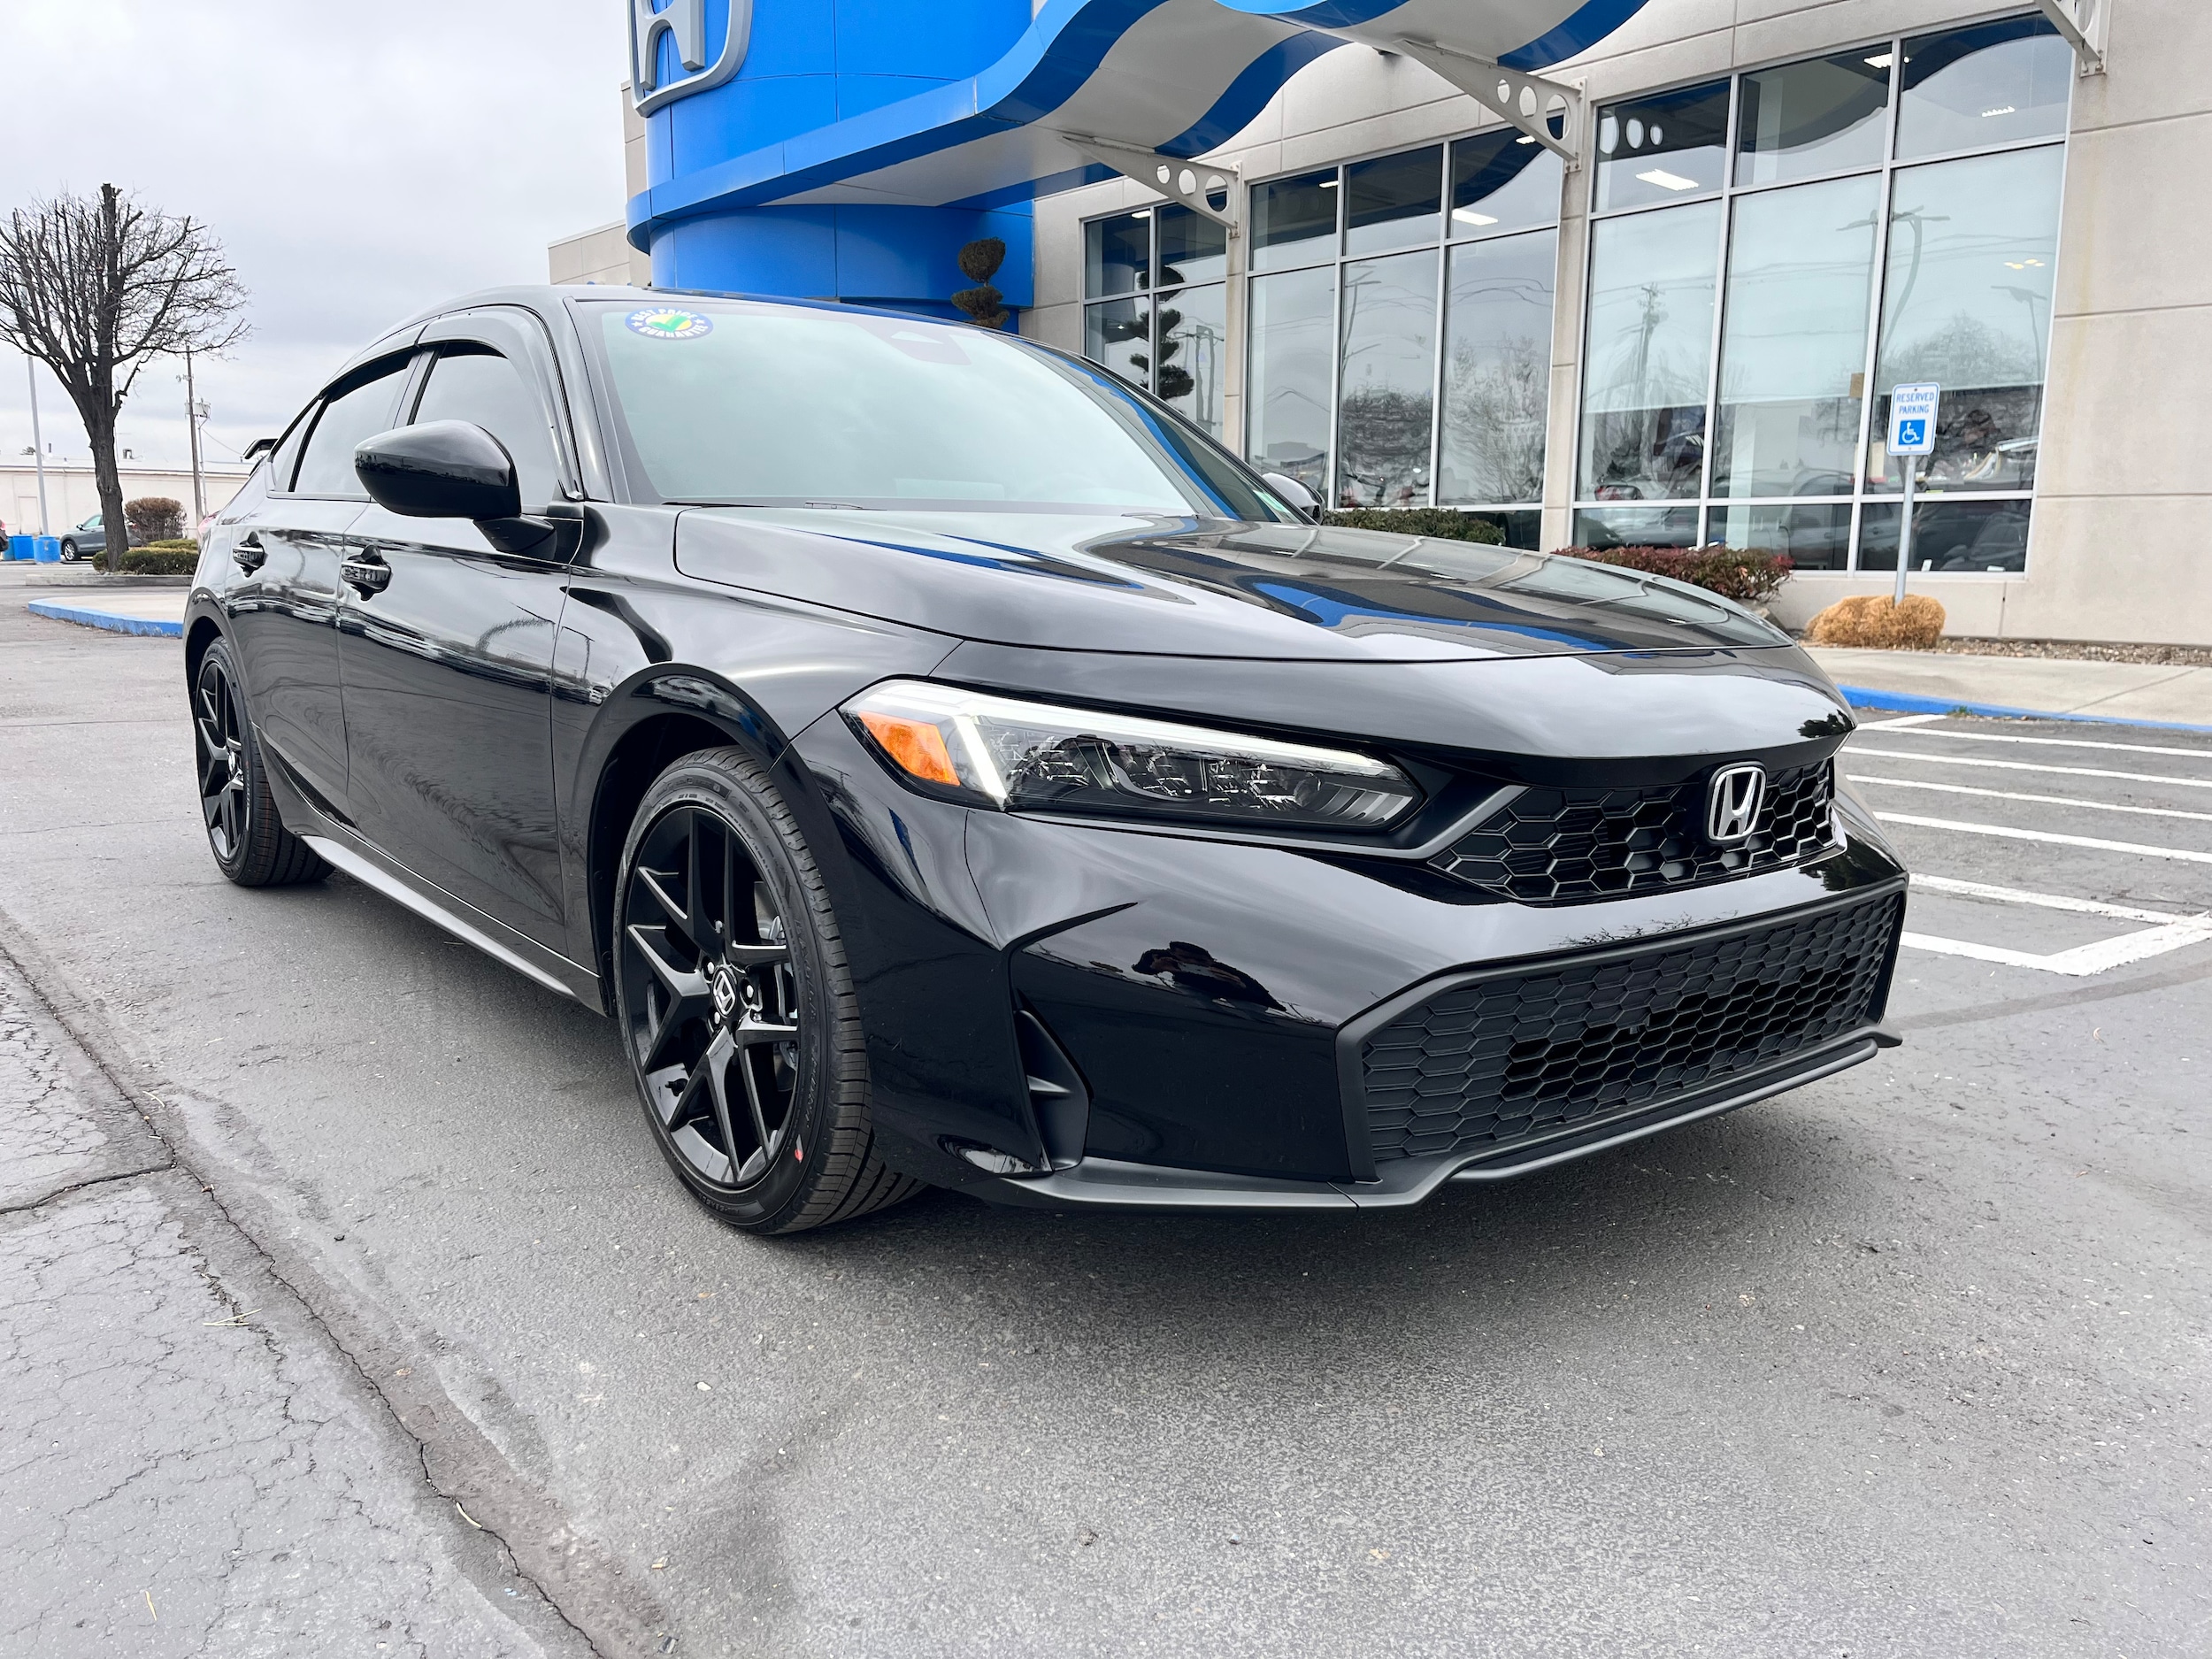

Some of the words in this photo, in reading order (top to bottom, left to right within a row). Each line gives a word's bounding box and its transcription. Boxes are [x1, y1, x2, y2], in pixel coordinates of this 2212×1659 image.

[657, 308, 698, 319] PRICE
[638, 324, 709, 338] GUARANTEE
[1896, 392, 1935, 403] RESERVED
[1899, 404, 1930, 414] PARKING
